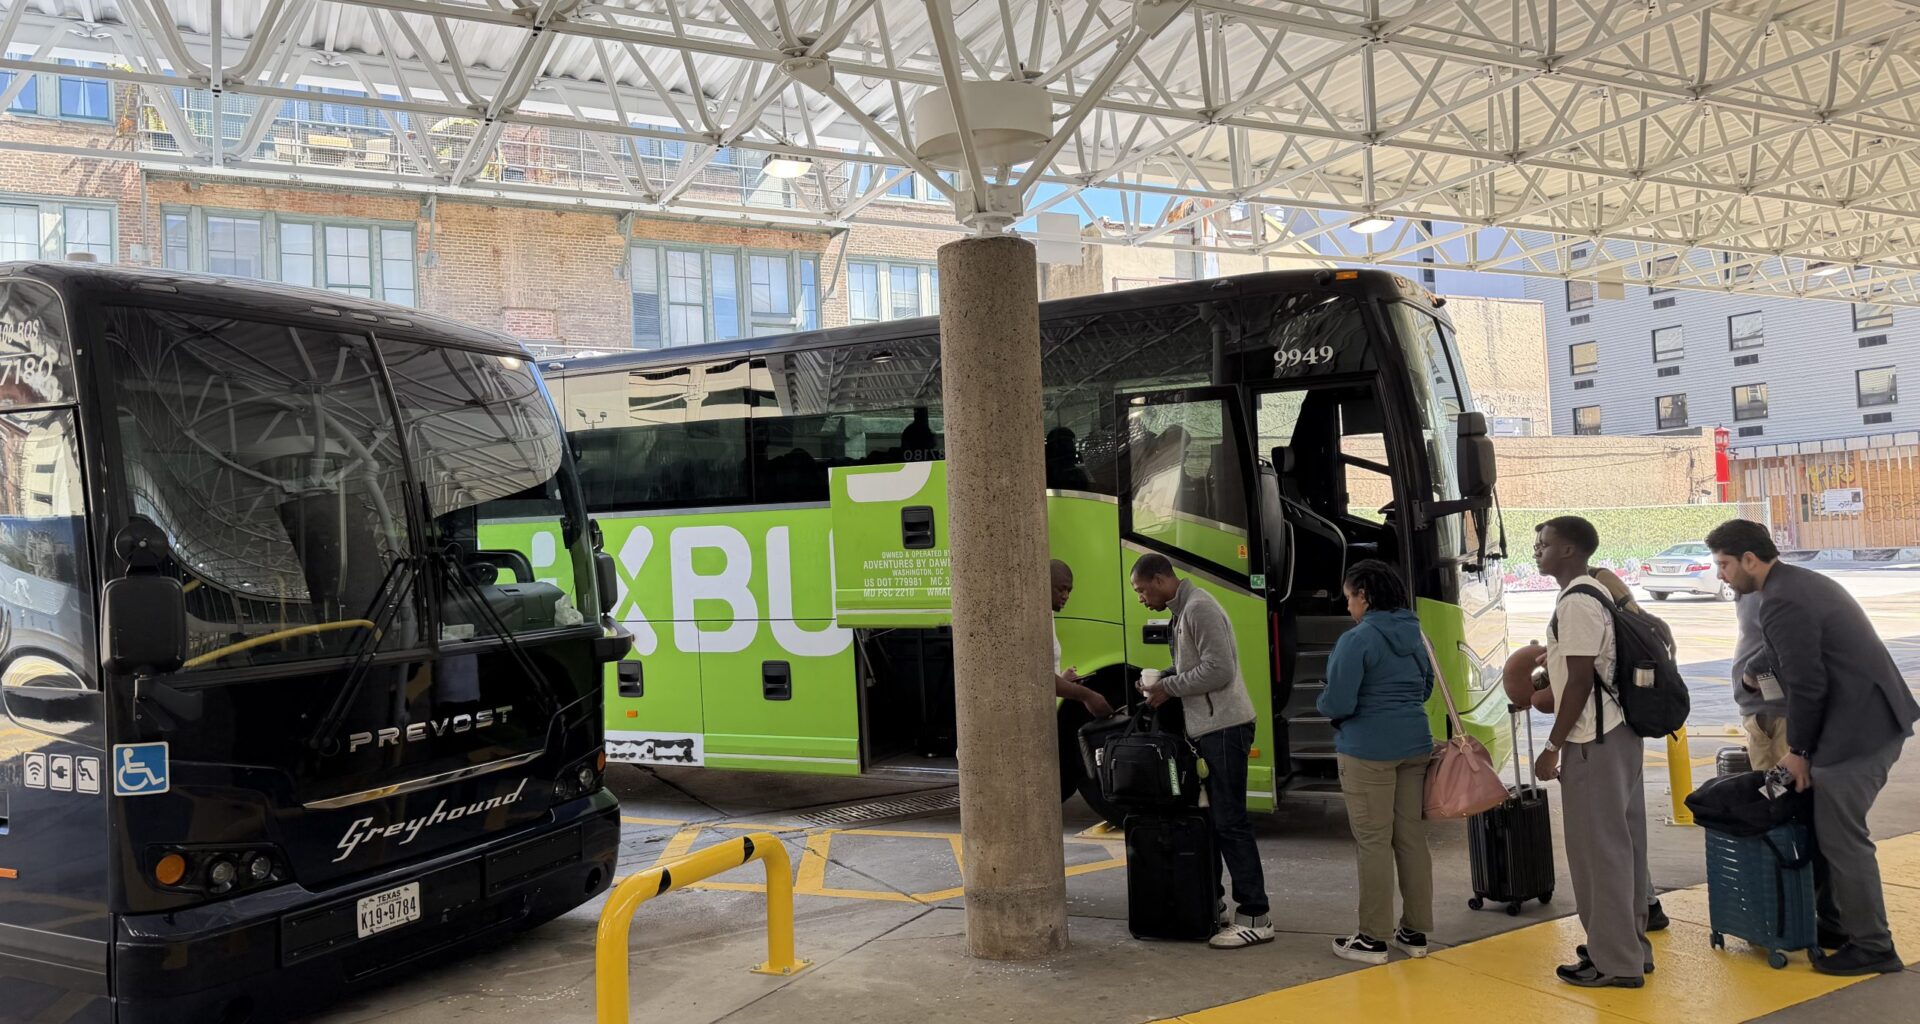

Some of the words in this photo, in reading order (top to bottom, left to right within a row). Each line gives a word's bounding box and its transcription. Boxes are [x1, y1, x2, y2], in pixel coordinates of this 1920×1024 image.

[1273, 345, 1334, 368] 9949
[0, 356, 53, 386] 7180
[882, 551, 904, 559] OWNED
[863, 559, 914, 570] ADVENTURES
[916, 559, 926, 568] BY
[614, 525, 854, 657] XBU
[864, 578, 875, 587] US
[877, 578, 892, 587] DOT
[930, 577, 943, 586] MC
[863, 588, 875, 597] MD
[877, 588, 893, 597] PSC
[927, 587, 951, 597] WMAT
[350, 705, 513, 752] PREVOST
[331, 777, 528, 863] Greyhound
[377, 889, 401, 903] TEXAS
